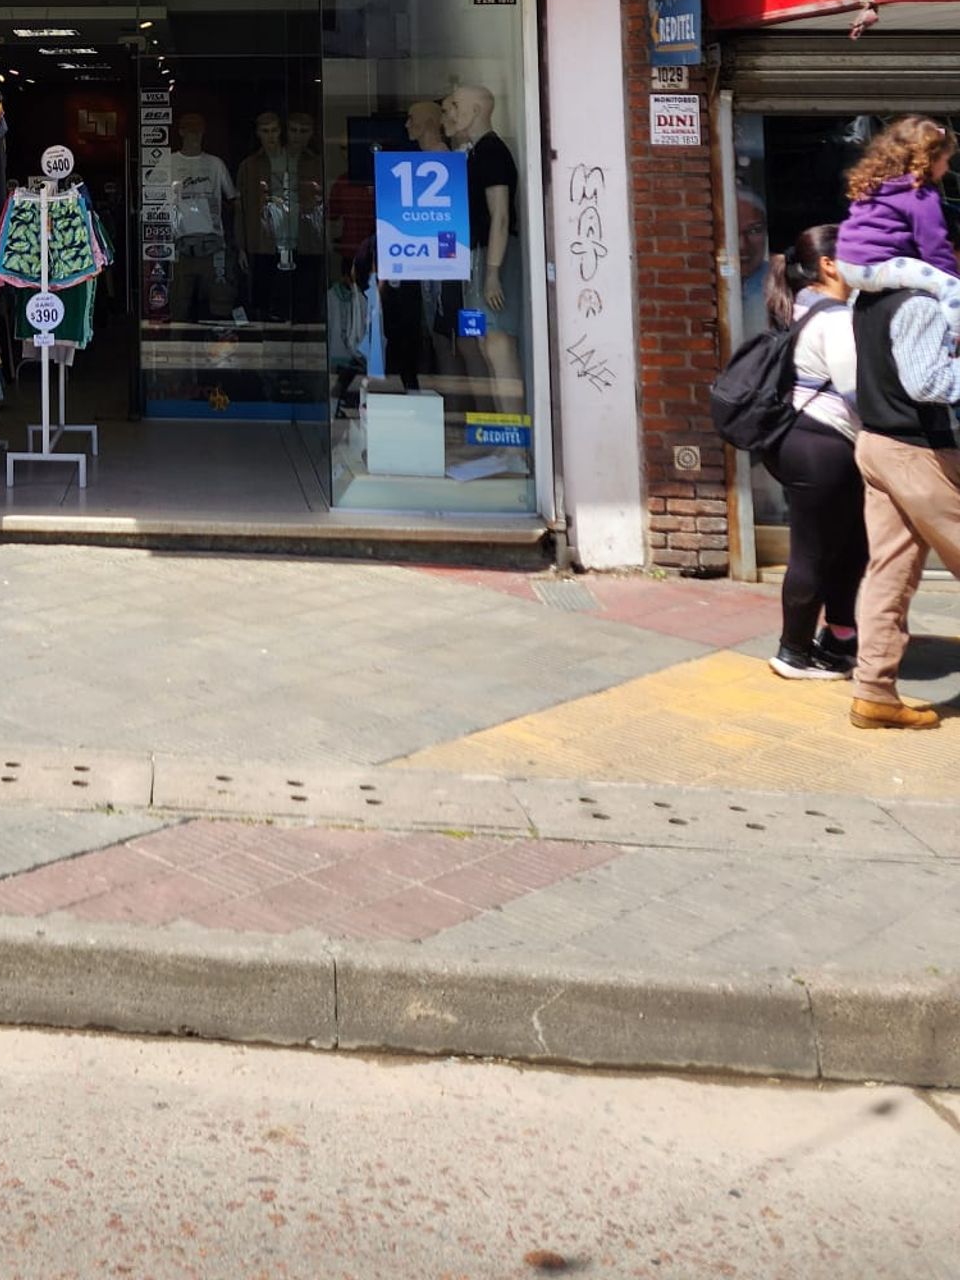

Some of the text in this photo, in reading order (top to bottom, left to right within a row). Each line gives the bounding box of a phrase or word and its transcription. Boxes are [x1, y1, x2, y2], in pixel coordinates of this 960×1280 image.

[657, 66, 684, 82] 1029
[657, 114, 696, 127] DINI
[46, 158, 70, 174] $400
[390, 161, 451, 207] 12
[402, 210, 451, 221] cuotas
[389, 244, 429, 257] OCA
[30, 308, 58, 323] $390
[464, 327, 481, 336] VISA
